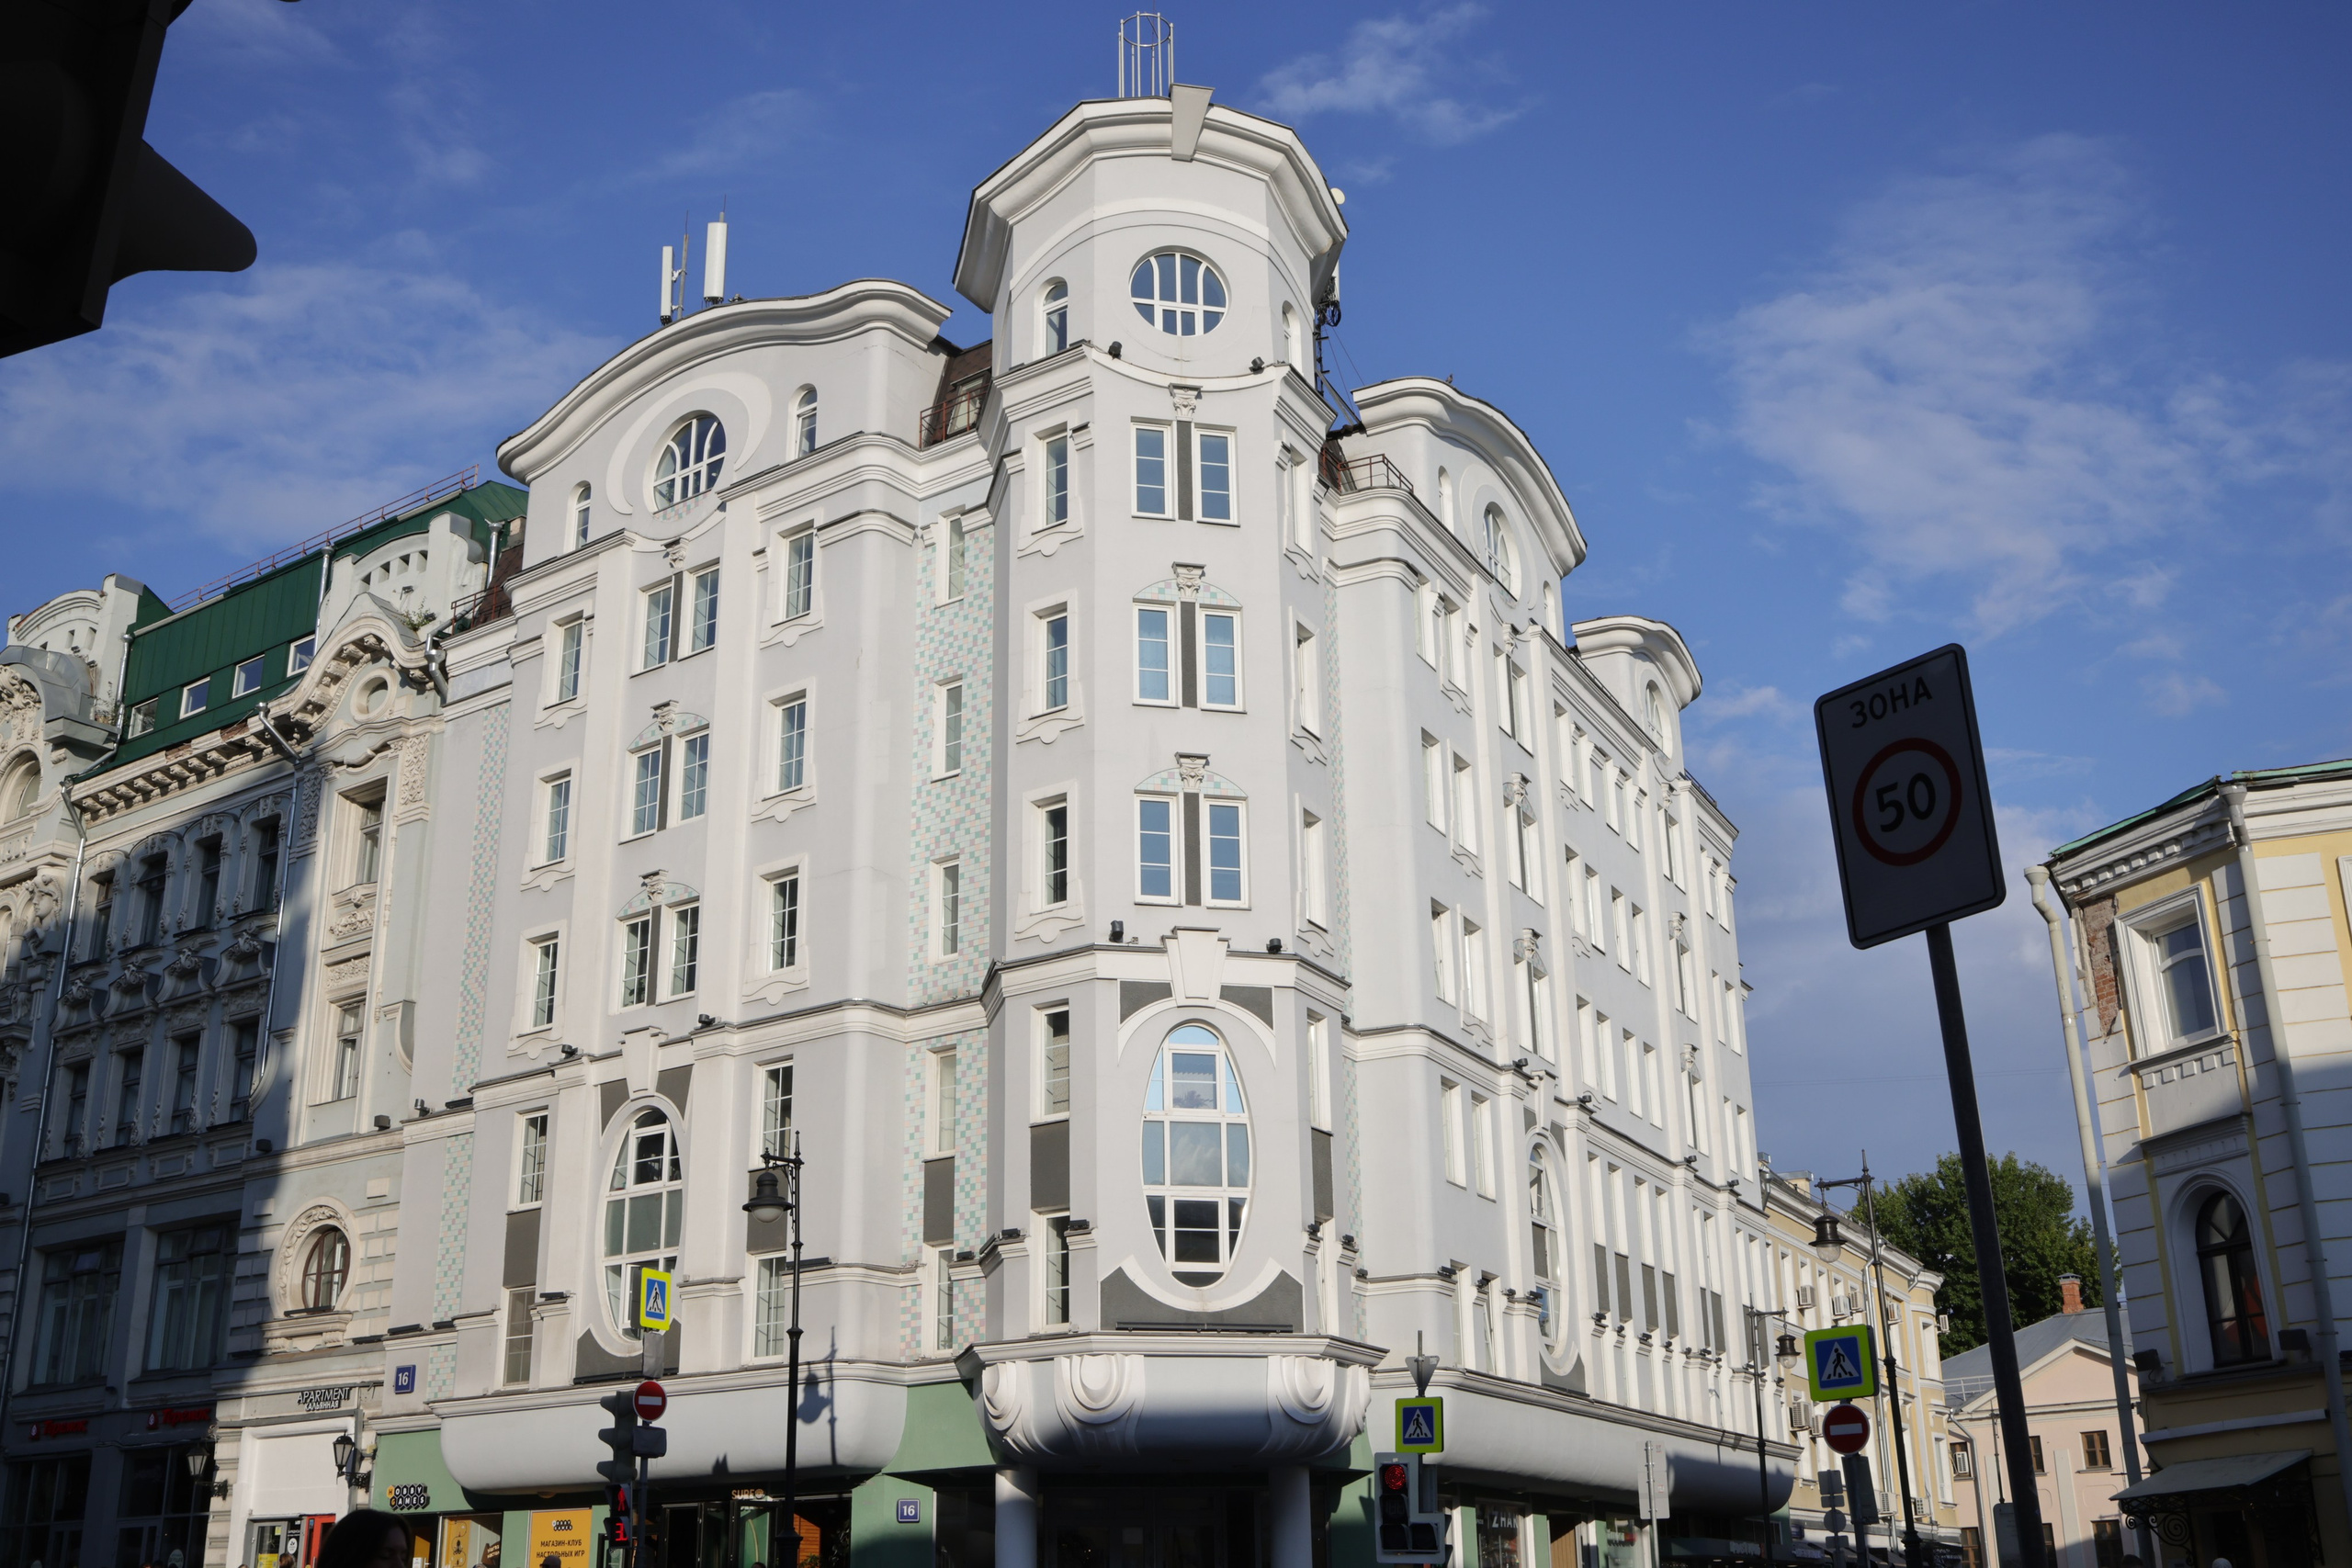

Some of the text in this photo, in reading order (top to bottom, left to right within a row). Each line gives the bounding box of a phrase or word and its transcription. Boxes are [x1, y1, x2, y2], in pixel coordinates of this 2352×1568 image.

[1849, 676, 1932, 728] ЗОНА
[1875, 773, 1936, 832] 50
[398, 1371, 409, 1385] 16
[297, 1387, 350, 1404] APARTMENT
[305, 1400, 340, 1411] КАЛЬЯННАЯ
[388, 1485, 424, 1496] HOBBY
[390, 1495, 425, 1506] GAMES
[902, 1505, 915, 1516] 16
[540, 1539, 582, 1548] МАГАЗИН-КЛУБ
